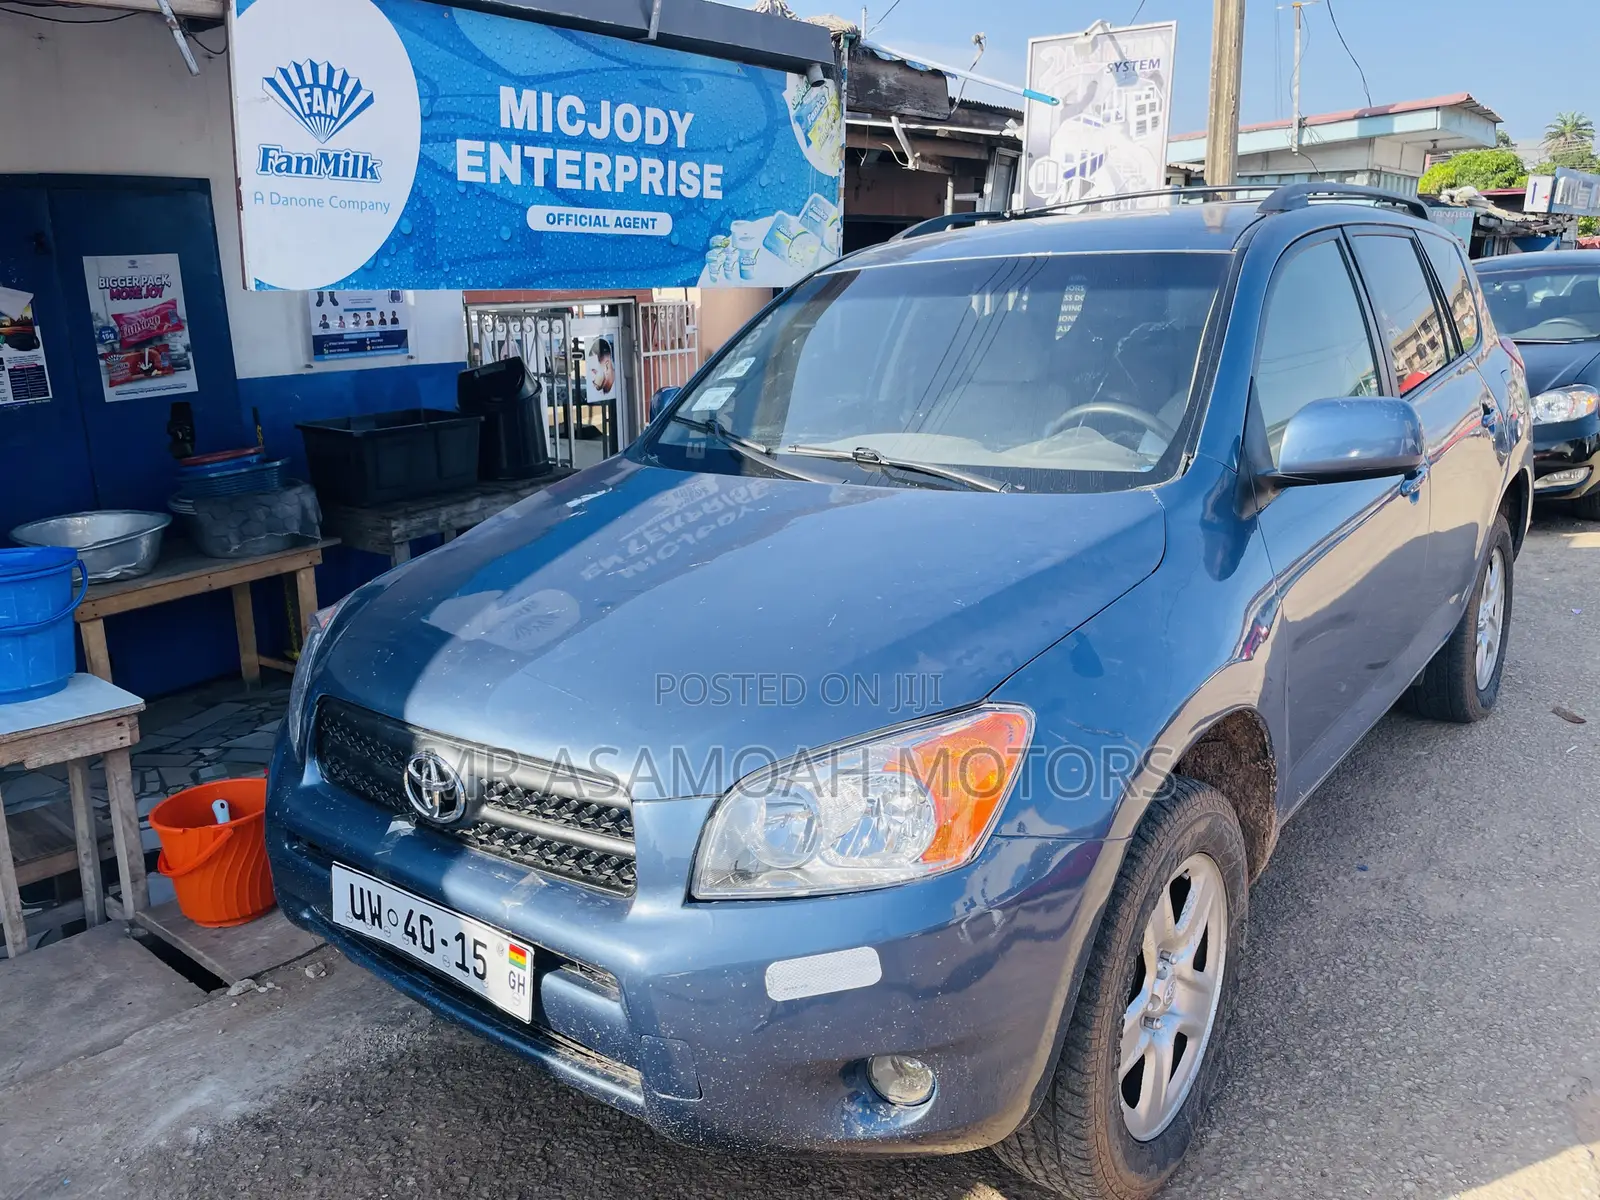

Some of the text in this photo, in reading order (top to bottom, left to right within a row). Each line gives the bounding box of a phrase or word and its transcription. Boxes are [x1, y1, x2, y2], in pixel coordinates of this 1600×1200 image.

[1106, 58, 1161, 74] SYSTEM
[298, 86, 342, 118] FAN
[499, 85, 695, 148] MICJODY
[257, 144, 382, 182] FanMilk
[456, 139, 724, 200] ENTERPRISE
[254, 191, 391, 214] A Danone Company
[546, 212, 658, 230] OFFICIAL AGENT
[98, 276, 139, 289] BIGGER
[109, 285, 165, 301] MORE JOY
[350, 883, 383, 930] UW
[508, 969, 526, 996] GH
